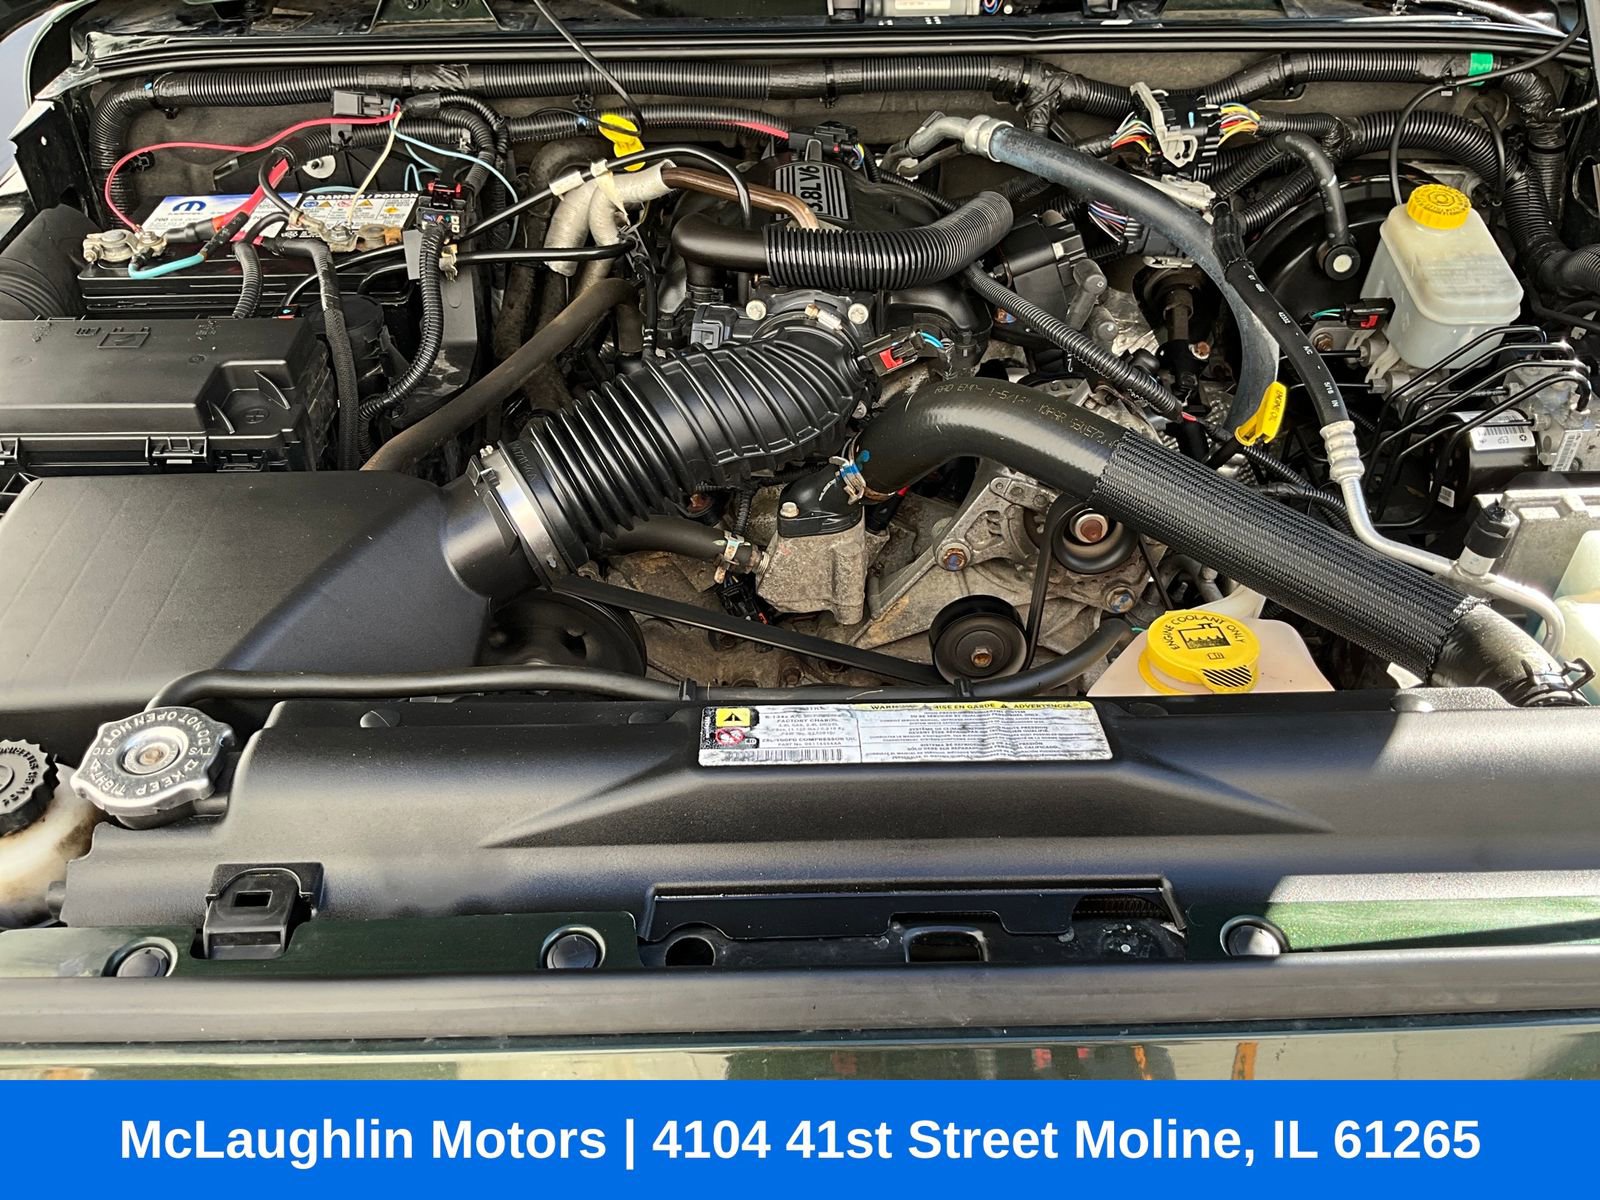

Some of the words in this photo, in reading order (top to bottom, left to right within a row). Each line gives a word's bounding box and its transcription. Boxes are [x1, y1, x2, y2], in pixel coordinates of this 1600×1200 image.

[798, 165, 820, 182] V6
[1162, 624, 1180, 650] ENGINE
[1171, 614, 1225, 625] COOLANT
[1226, 624, 1247, 644] ONLY
[132, 711, 178, 727] OPEN
[178, 714, 204, 732] NOT
[103, 721, 133, 746] HOT
[196, 729, 212, 746] DO
[188, 747, 213, 756] TVS
[89, 771, 126, 796] TIGHT
[136, 771, 185, 796] KEEP
